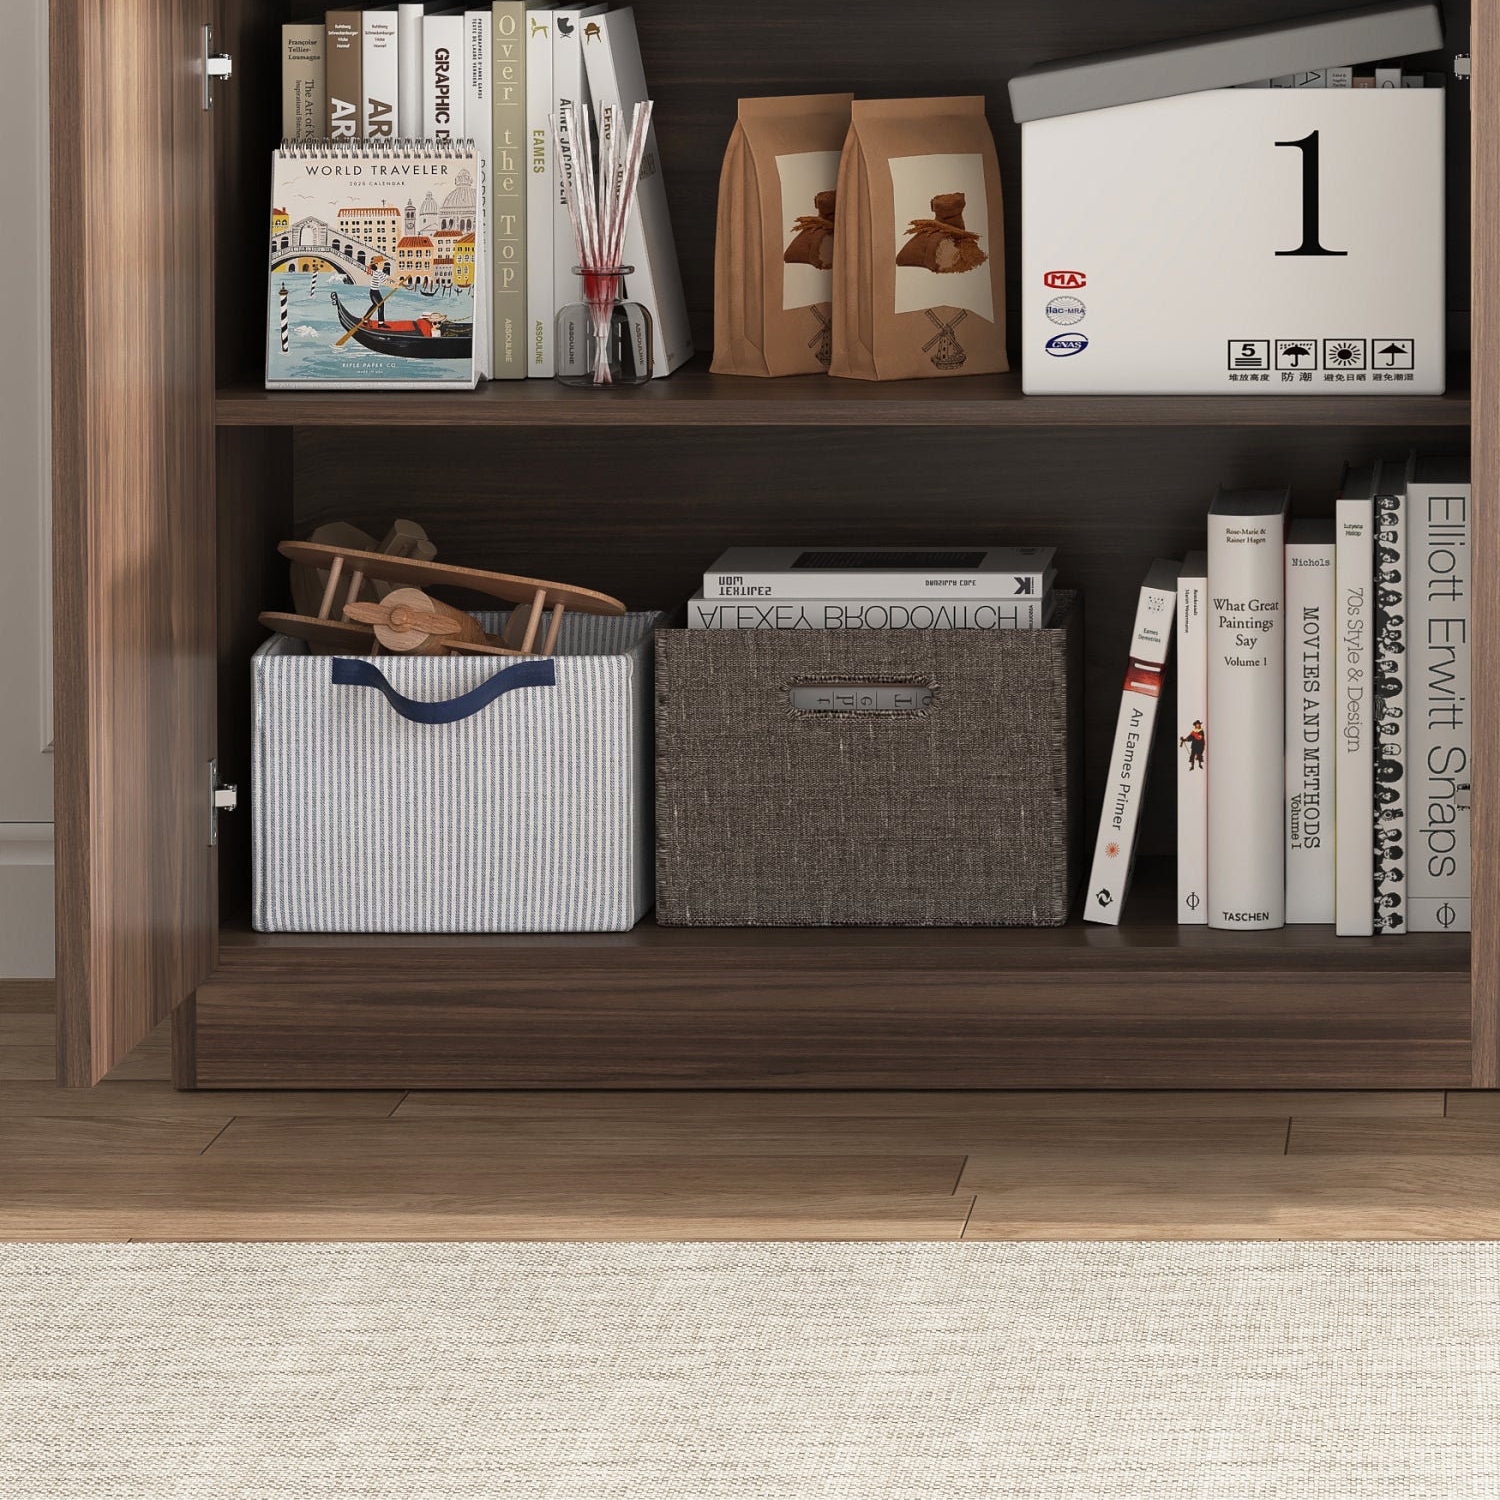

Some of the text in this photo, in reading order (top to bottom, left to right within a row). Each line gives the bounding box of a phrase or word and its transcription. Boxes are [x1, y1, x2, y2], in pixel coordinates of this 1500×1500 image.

[435, 47, 450, 124] GRAPHIC
[532, 130, 546, 174] EAMES
[306, 165, 448, 176] WORLD TRAVELER
[1274, 130, 1348, 256] 1
[535, 320, 544, 364] ASSOULINE
[1052, 340, 1082, 348] CNAS
[1241, 343, 1256, 357] 5
[1228, 373, 1270, 382] 堆放高度
[1323, 373, 1366, 382] 避免日晒
[1226, 536, 1266, 544] Rainer Hagen
[1292, 558, 1330, 567] Nichols
[1213, 598, 1279, 612] What Great
[1218, 616, 1274, 632] Paintings
[1235, 634, 1258, 650] Say
[1224, 656, 1260, 666] Volume
[1344, 587, 1364, 753] 70s Style & Design
[1420, 496, 1466, 878] Elliott Erwitt Snaps
[1303, 606, 1320, 849] MOVIES AND METHODS
[1112, 708, 1144, 831] An Eames Primer
[1291, 794, 1302, 840] Volume
[1222, 912, 1270, 922] TASCHEN
